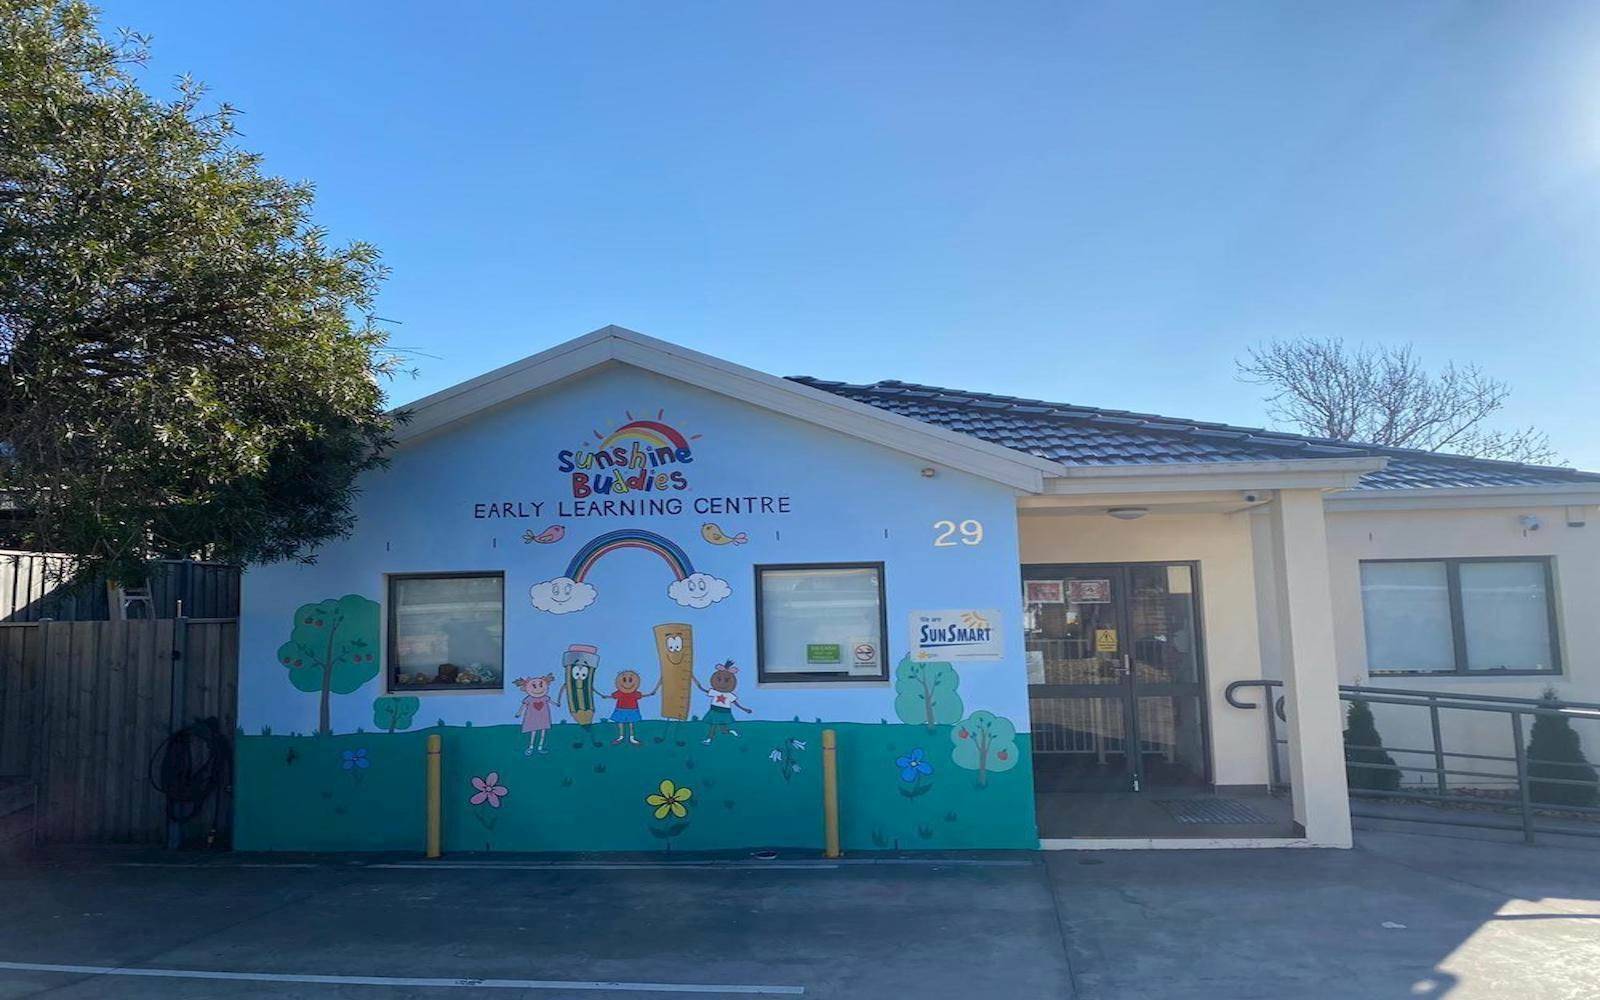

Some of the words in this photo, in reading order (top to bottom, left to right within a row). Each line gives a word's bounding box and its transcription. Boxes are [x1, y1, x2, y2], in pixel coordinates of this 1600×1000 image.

[558, 441, 694, 473] Sunshine
[571, 469, 689, 499] Buddies
[474, 501, 545, 519] EARLY
[558, 498, 683, 517] LEARNING
[694, 496, 791, 514] CENTRE
[933, 519, 984, 547] 29
